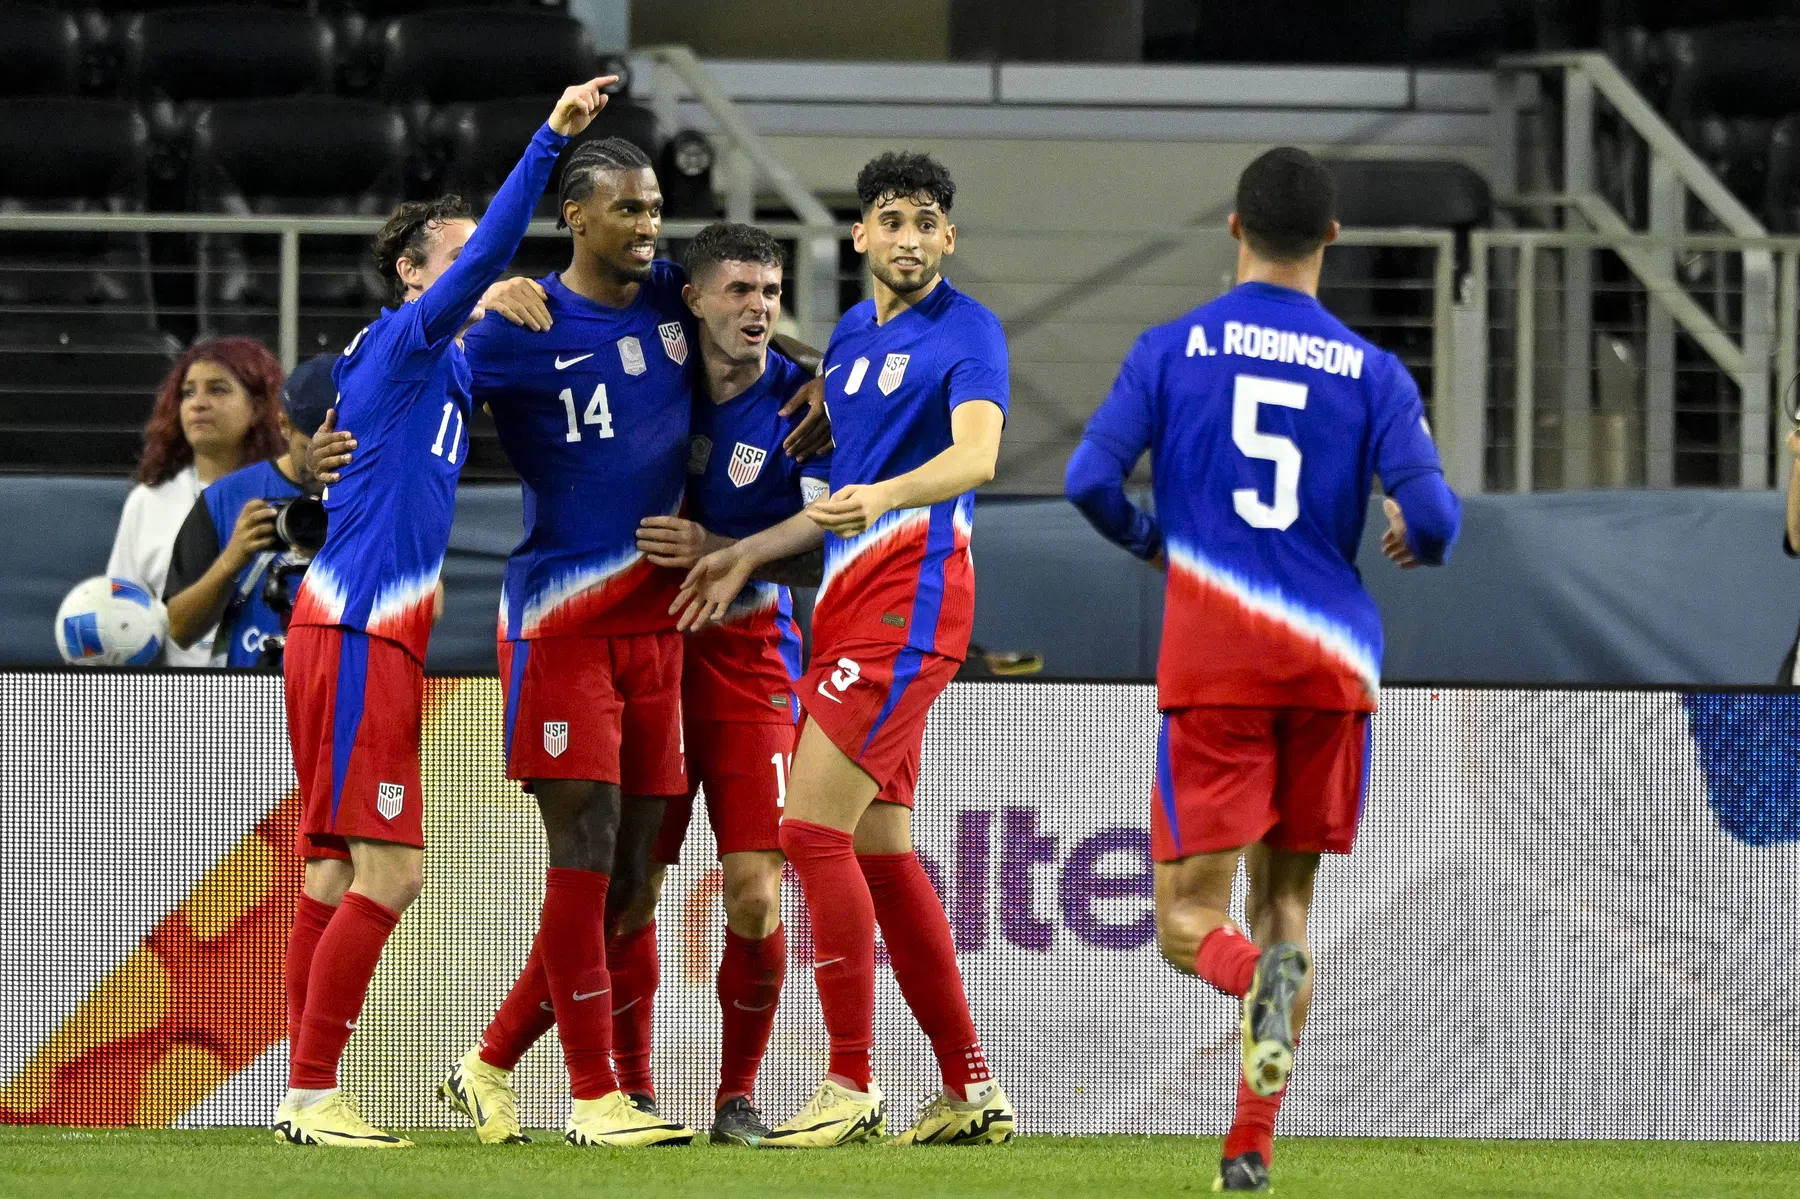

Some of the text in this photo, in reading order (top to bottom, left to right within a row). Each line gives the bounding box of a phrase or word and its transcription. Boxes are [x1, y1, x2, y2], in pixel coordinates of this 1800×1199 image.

[660, 323, 682, 341] USA
[1185, 320, 1365, 380] A. ROBINSON
[886, 356, 908, 371] USA
[558, 383, 615, 443] 14
[430, 401, 463, 465] 11
[735, 444, 764, 465] USA
[1231, 373, 1309, 532] 5
[545, 723, 567, 737] USA
[380, 784, 403, 799] USA
